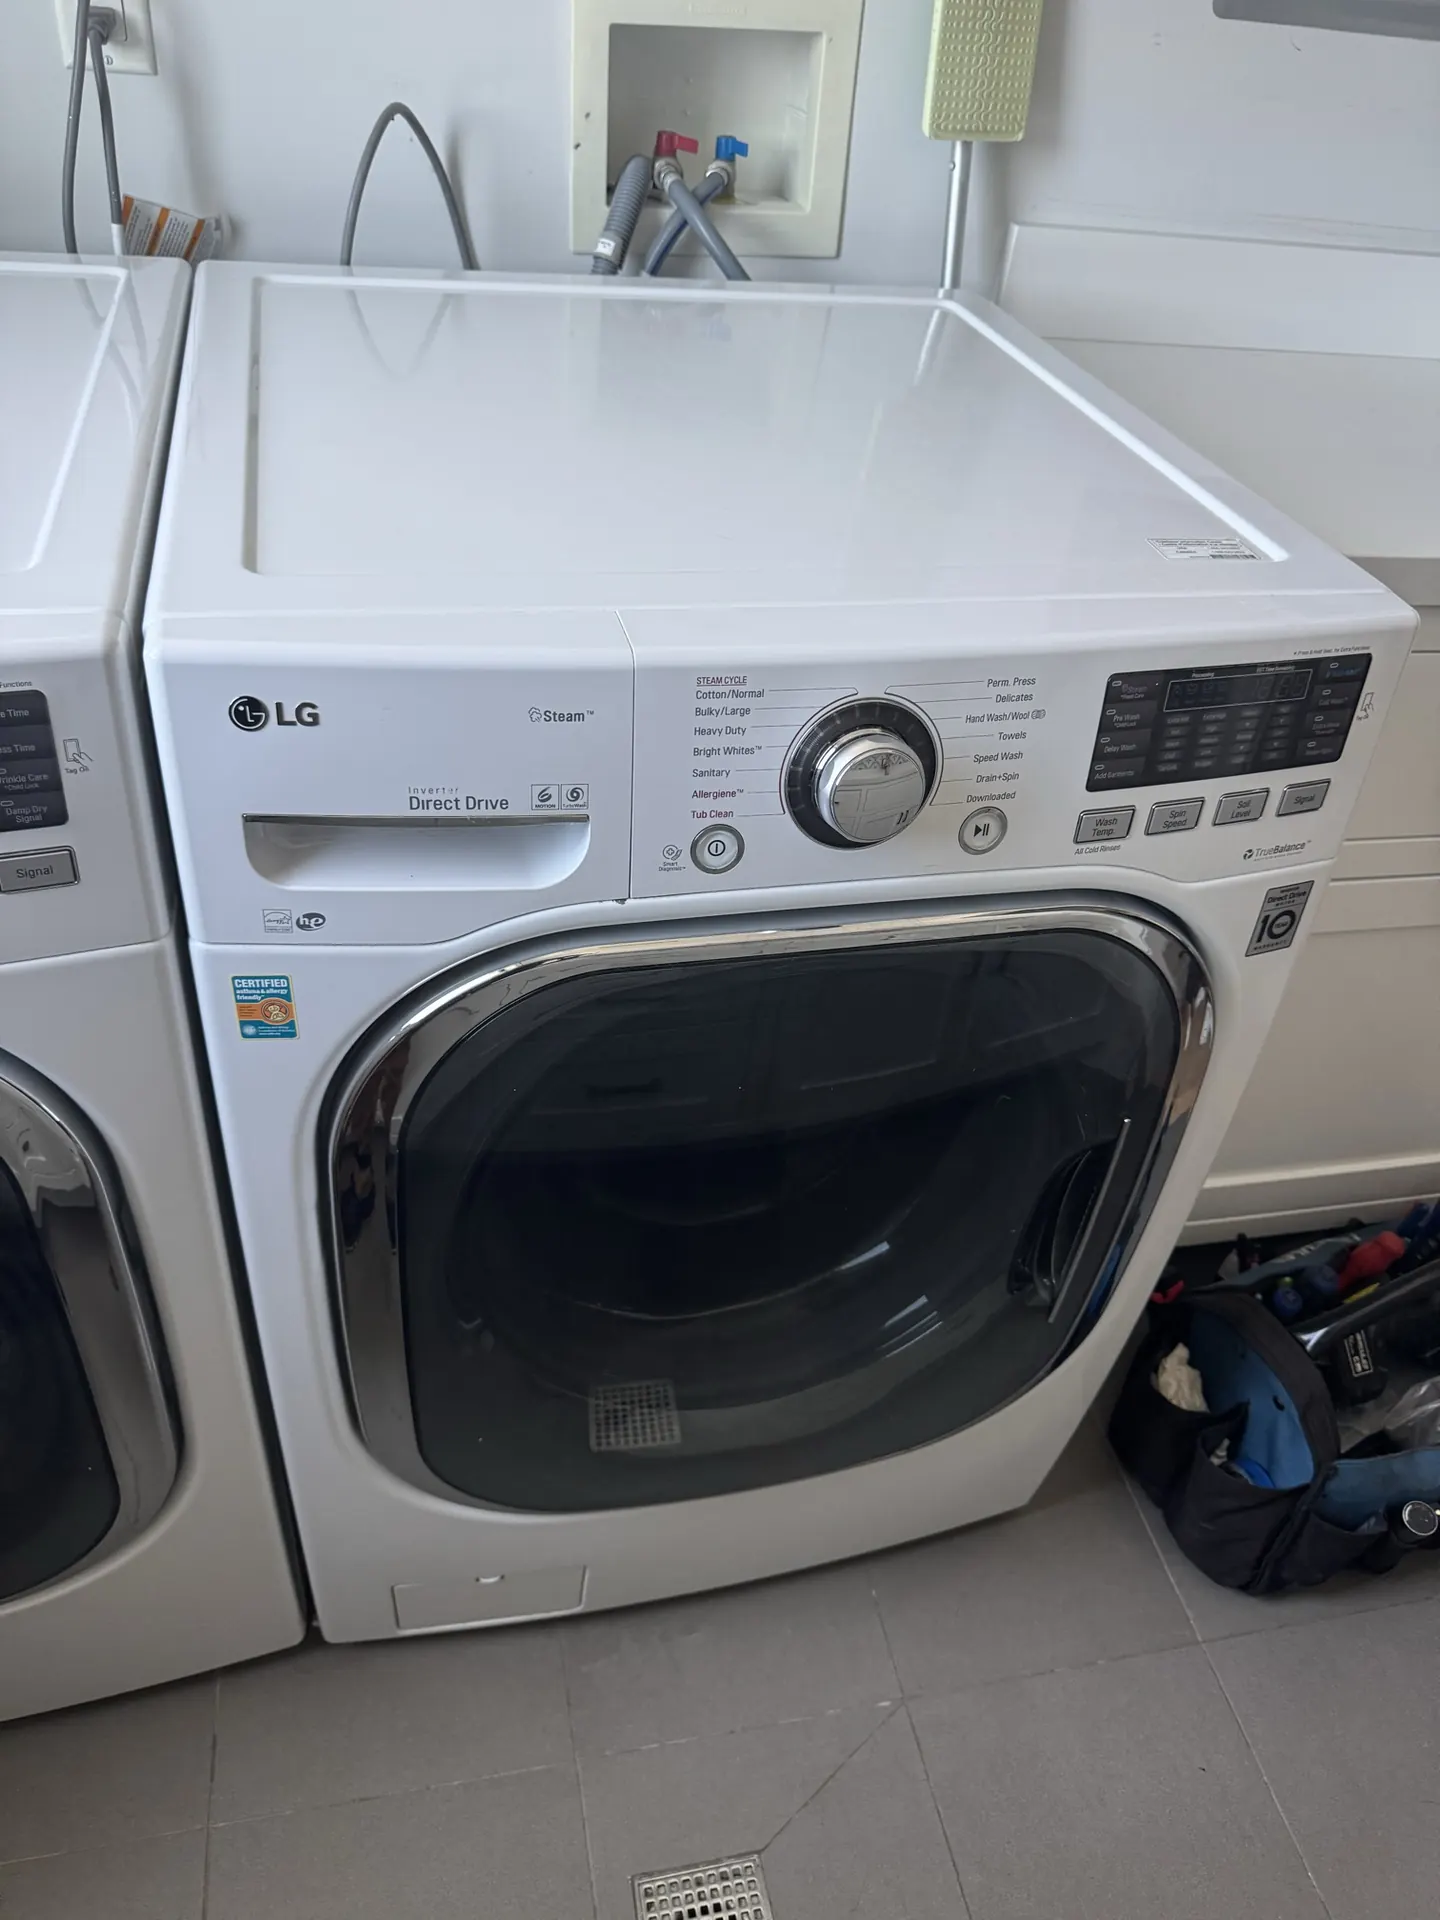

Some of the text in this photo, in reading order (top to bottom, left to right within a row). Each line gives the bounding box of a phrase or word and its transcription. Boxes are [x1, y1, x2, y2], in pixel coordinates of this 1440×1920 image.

[696, 675, 748, 685] STEAM CYCLE
[1013, 676, 1037, 686] Press
[695, 688, 765, 700] Cotton/Normal
[995, 693, 1034, 703] Delicates
[275, 701, 320, 727] LG
[694, 706, 751, 717] Bulky/Large
[965, 711, 1030, 723] Hand Wash/Wool
[694, 726, 747, 737] Heavy Duty
[998, 731, 1027, 741] Towels
[693, 747, 721, 757] Bright
[973, 750, 1024, 764] Speed Wash
[692, 768, 731, 778] Sanitary
[975, 771, 1020, 783] Drain+Spin
[966, 791, 1017, 803] Downloaded
[409, 796, 510, 811] Direct Drive
[691, 810, 734, 819] Tub Clean
[1168, 809, 1187, 820] Spin
[1230, 810, 1252, 819] Level
[1095, 817, 1118, 827] Wash
[1162, 819, 1188, 830] Speed
[1084, 845, 1099, 853] Cold
[16, 864, 54, 879] Signal
[234, 978, 289, 988] CERTIFIED
